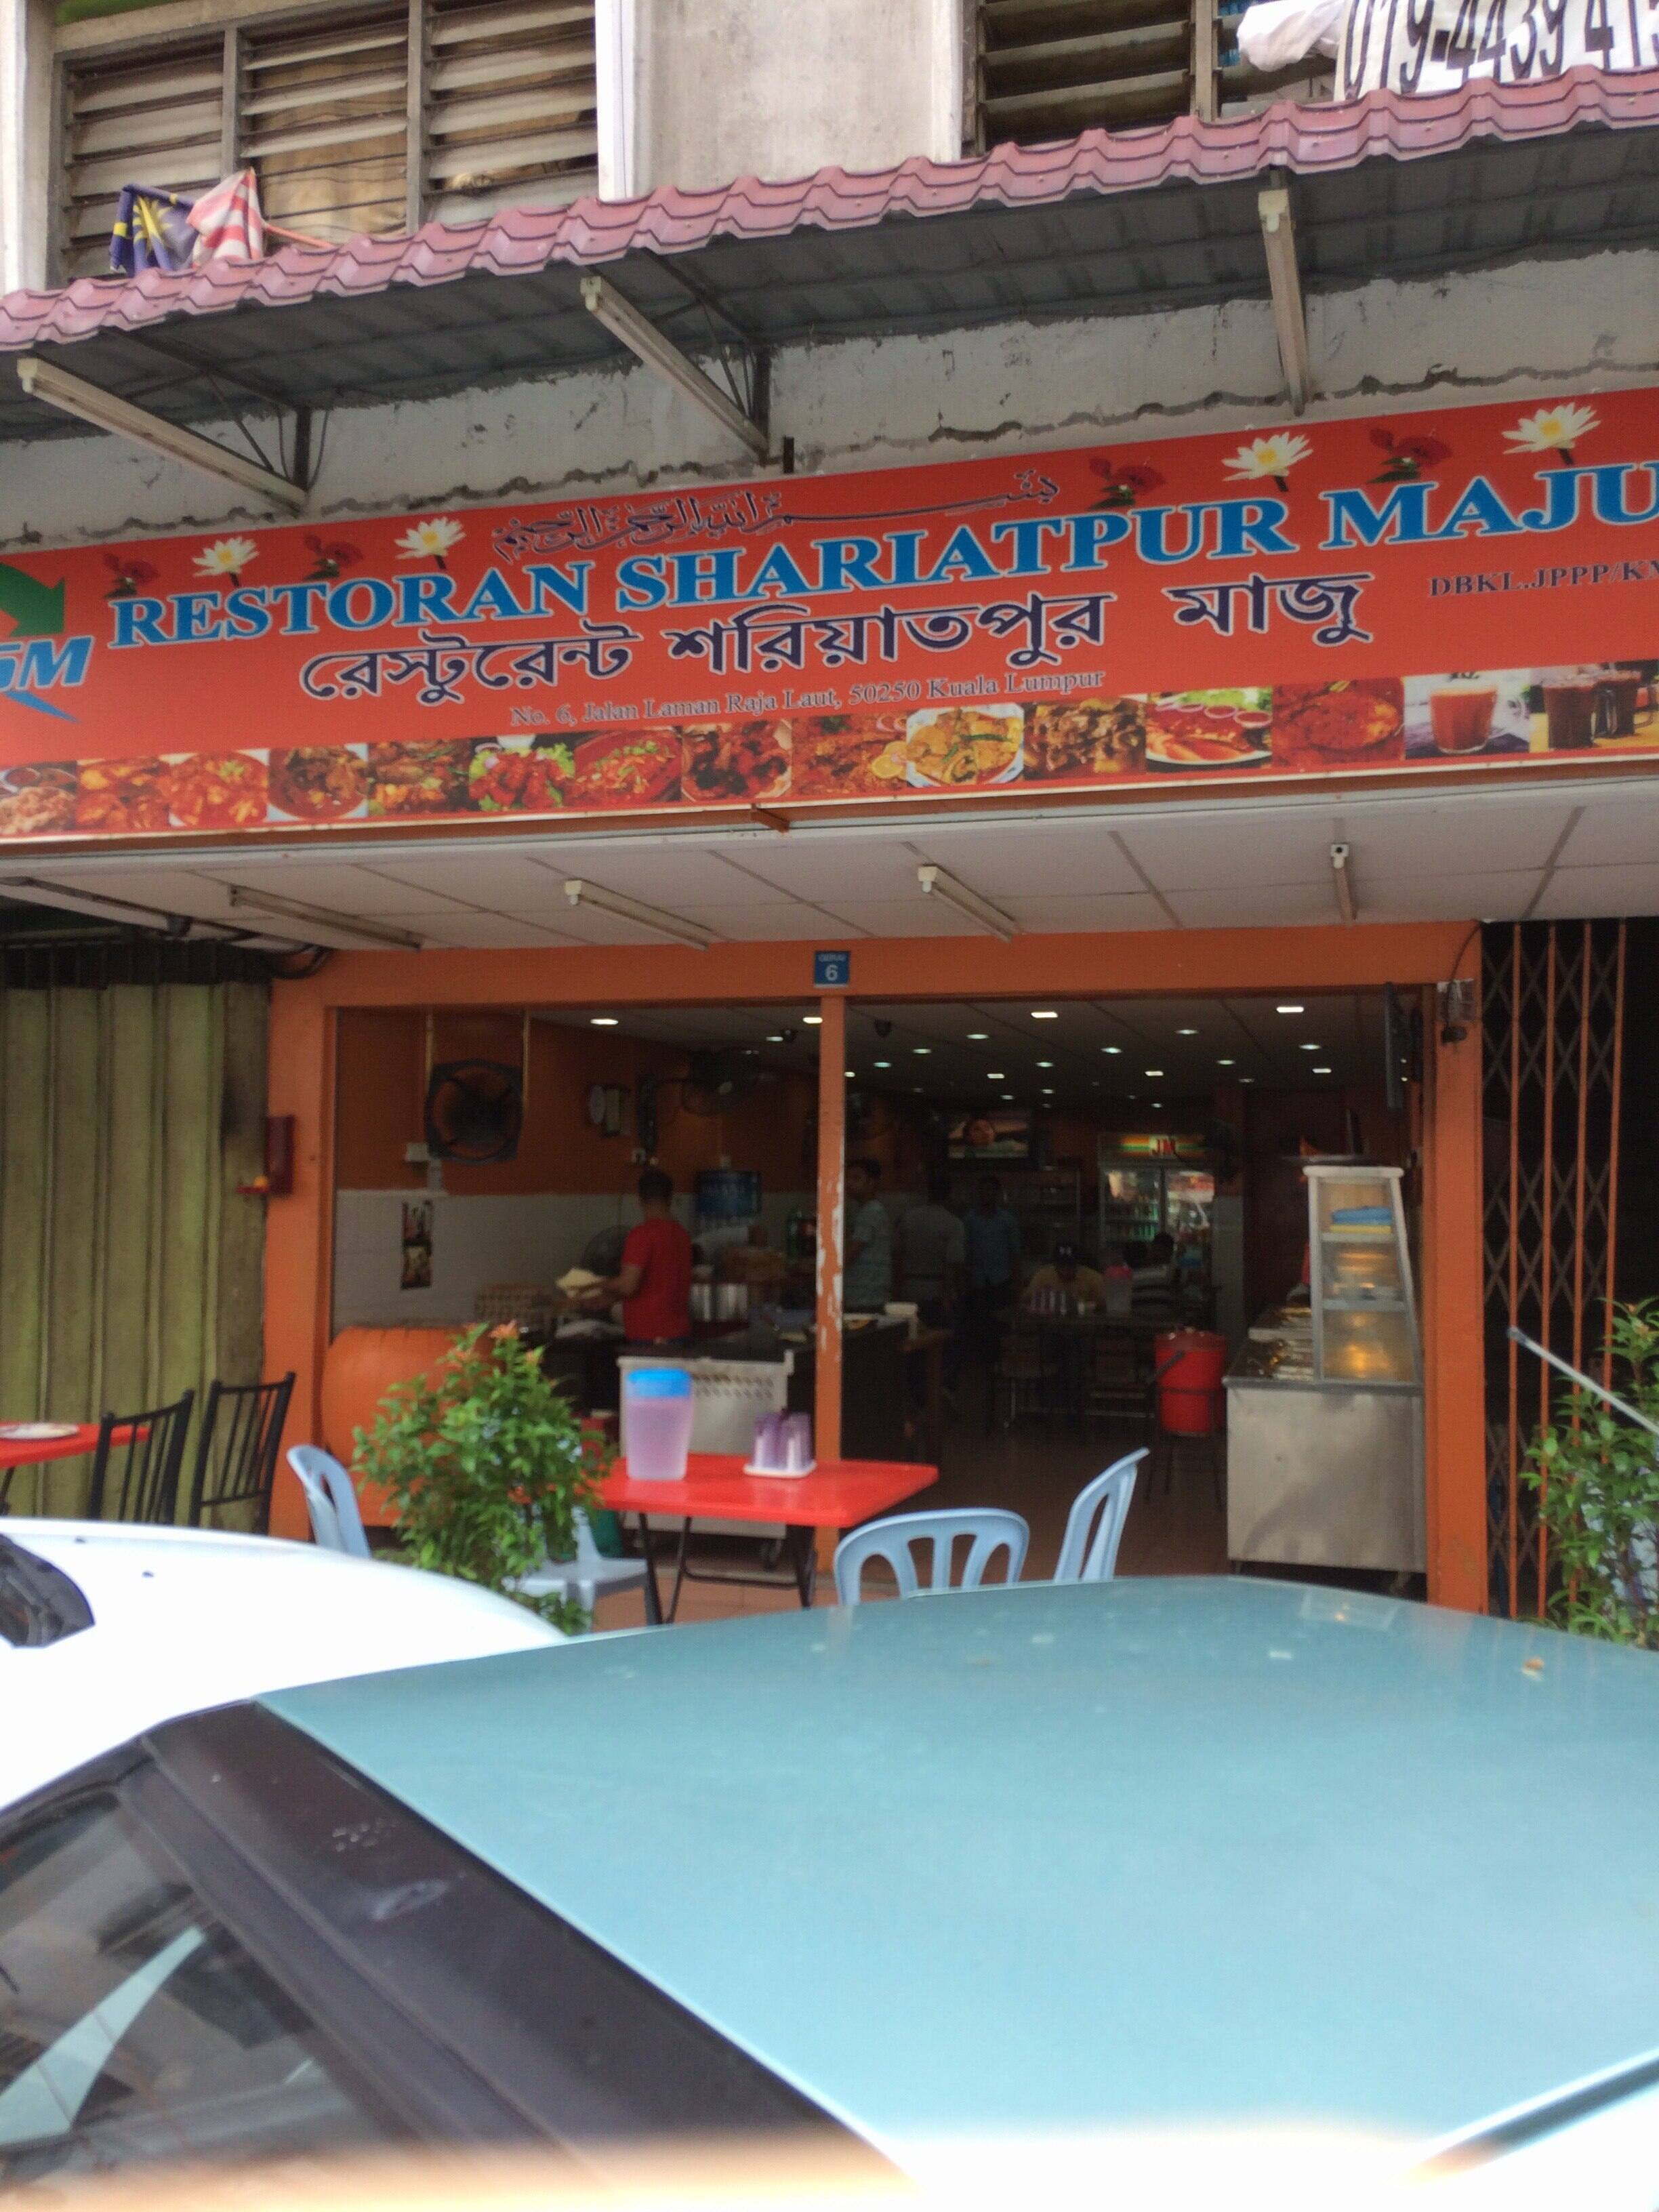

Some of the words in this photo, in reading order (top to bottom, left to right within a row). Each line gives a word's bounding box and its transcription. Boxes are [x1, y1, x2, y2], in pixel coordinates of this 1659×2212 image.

[108, 560, 594, 649] RESTORAN
[616, 497, 1297, 612] SHARIATPUR
[1320, 461, 1659, 552] MAJU
[300, 618, 643, 705] রেস্টুরেন্ট
[1163, 572, 1375, 647] মাজু
[510, 705, 548, 726] No.
[555, 703, 576, 726] 6,
[582, 702, 639, 722] Jalan
[642, 699, 720, 719] Laman
[725, 691, 777, 716] Raja
[783, 688, 842, 710] Laut,
[848, 681, 920, 705] 50250
[926, 677, 998, 699] Kuala
[1006, 670, 1104, 695] Lumpur
[825, 964, 839, 981] 6
